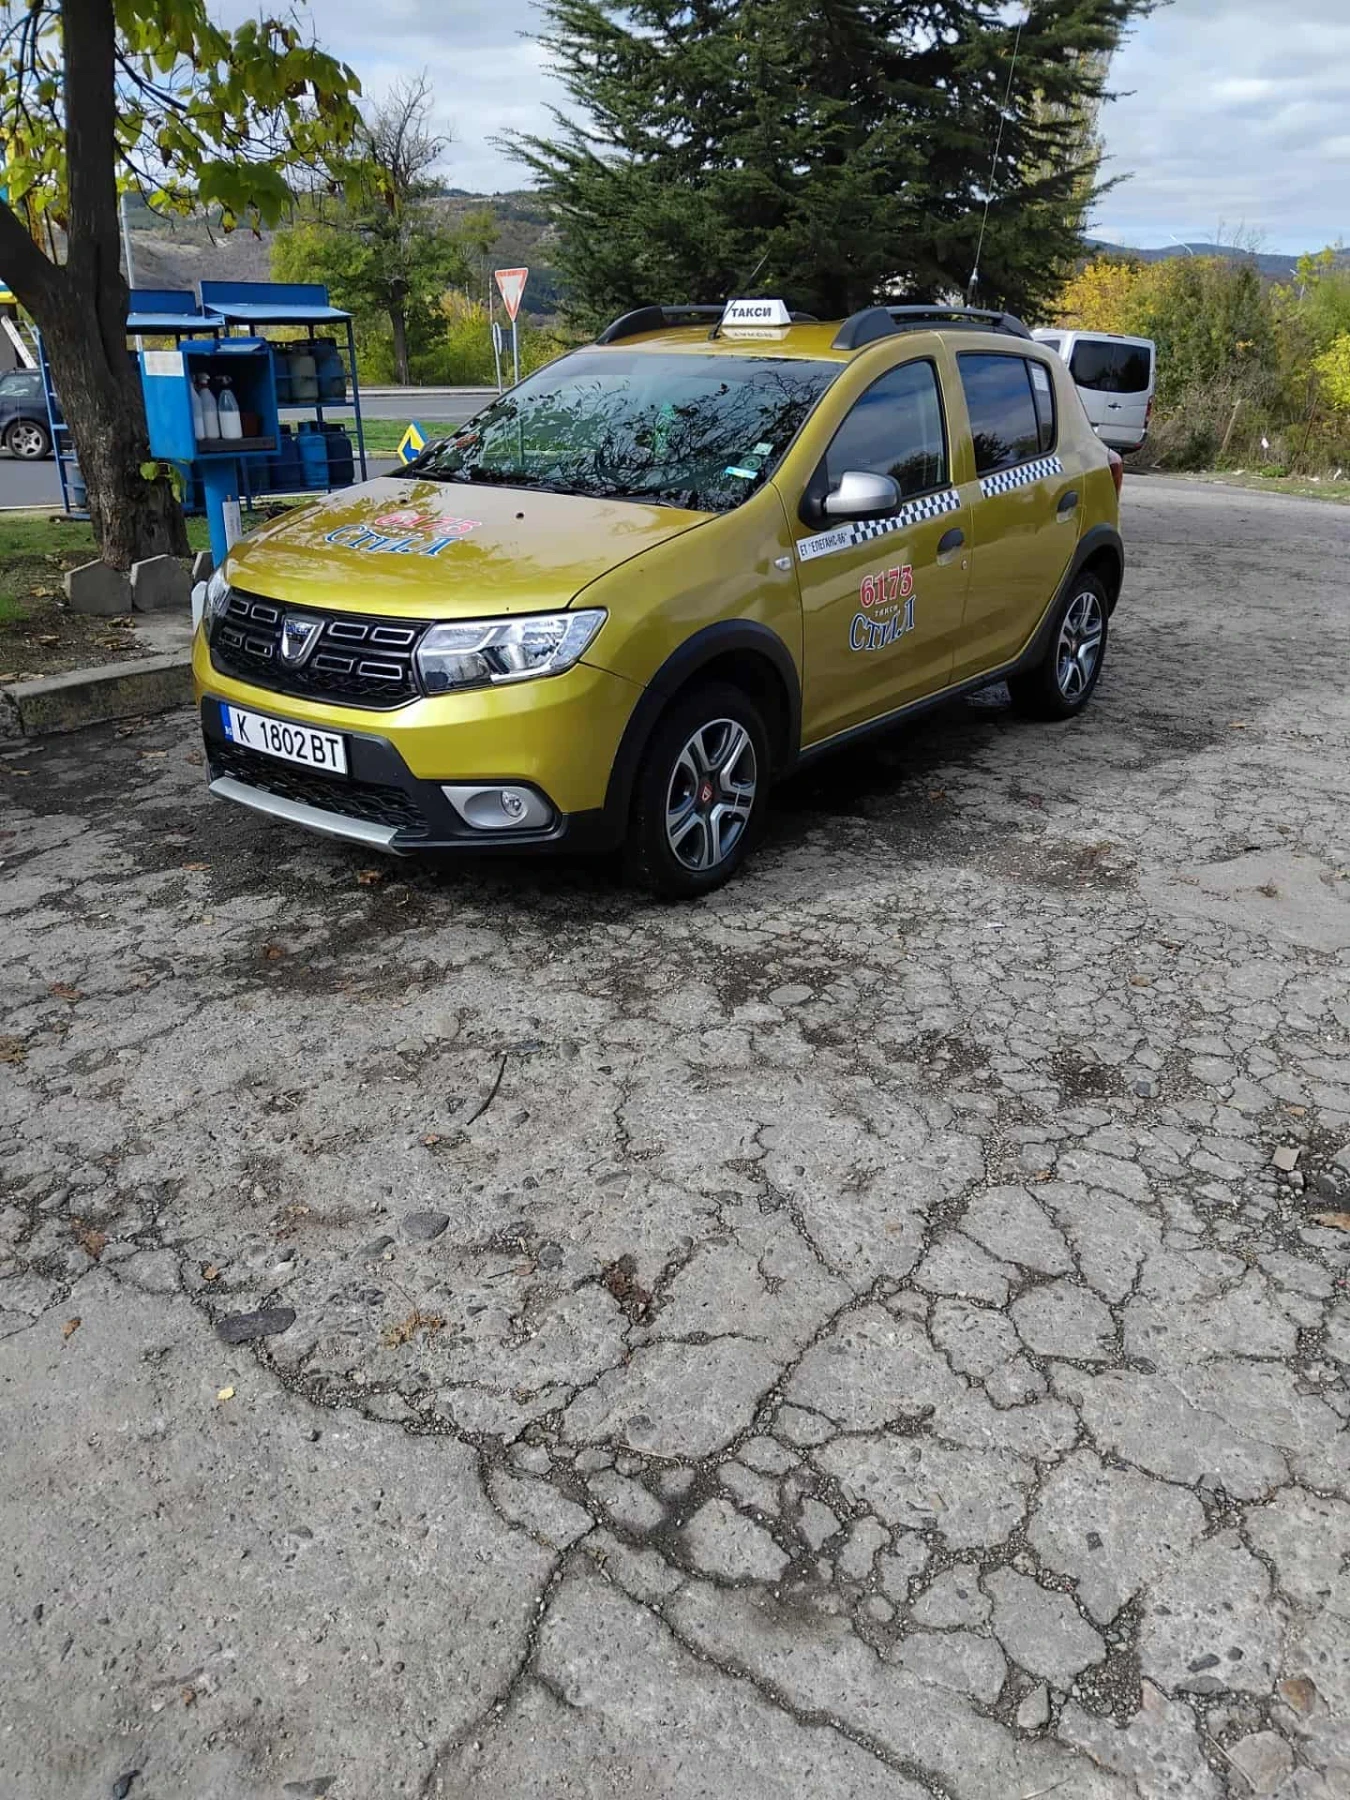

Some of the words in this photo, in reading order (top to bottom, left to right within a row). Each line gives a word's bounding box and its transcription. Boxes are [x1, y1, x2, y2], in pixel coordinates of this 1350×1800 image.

[732, 307, 772, 318] ТАКСИ
[861, 564, 913, 608] 6173
[237, 713, 251, 743] K
